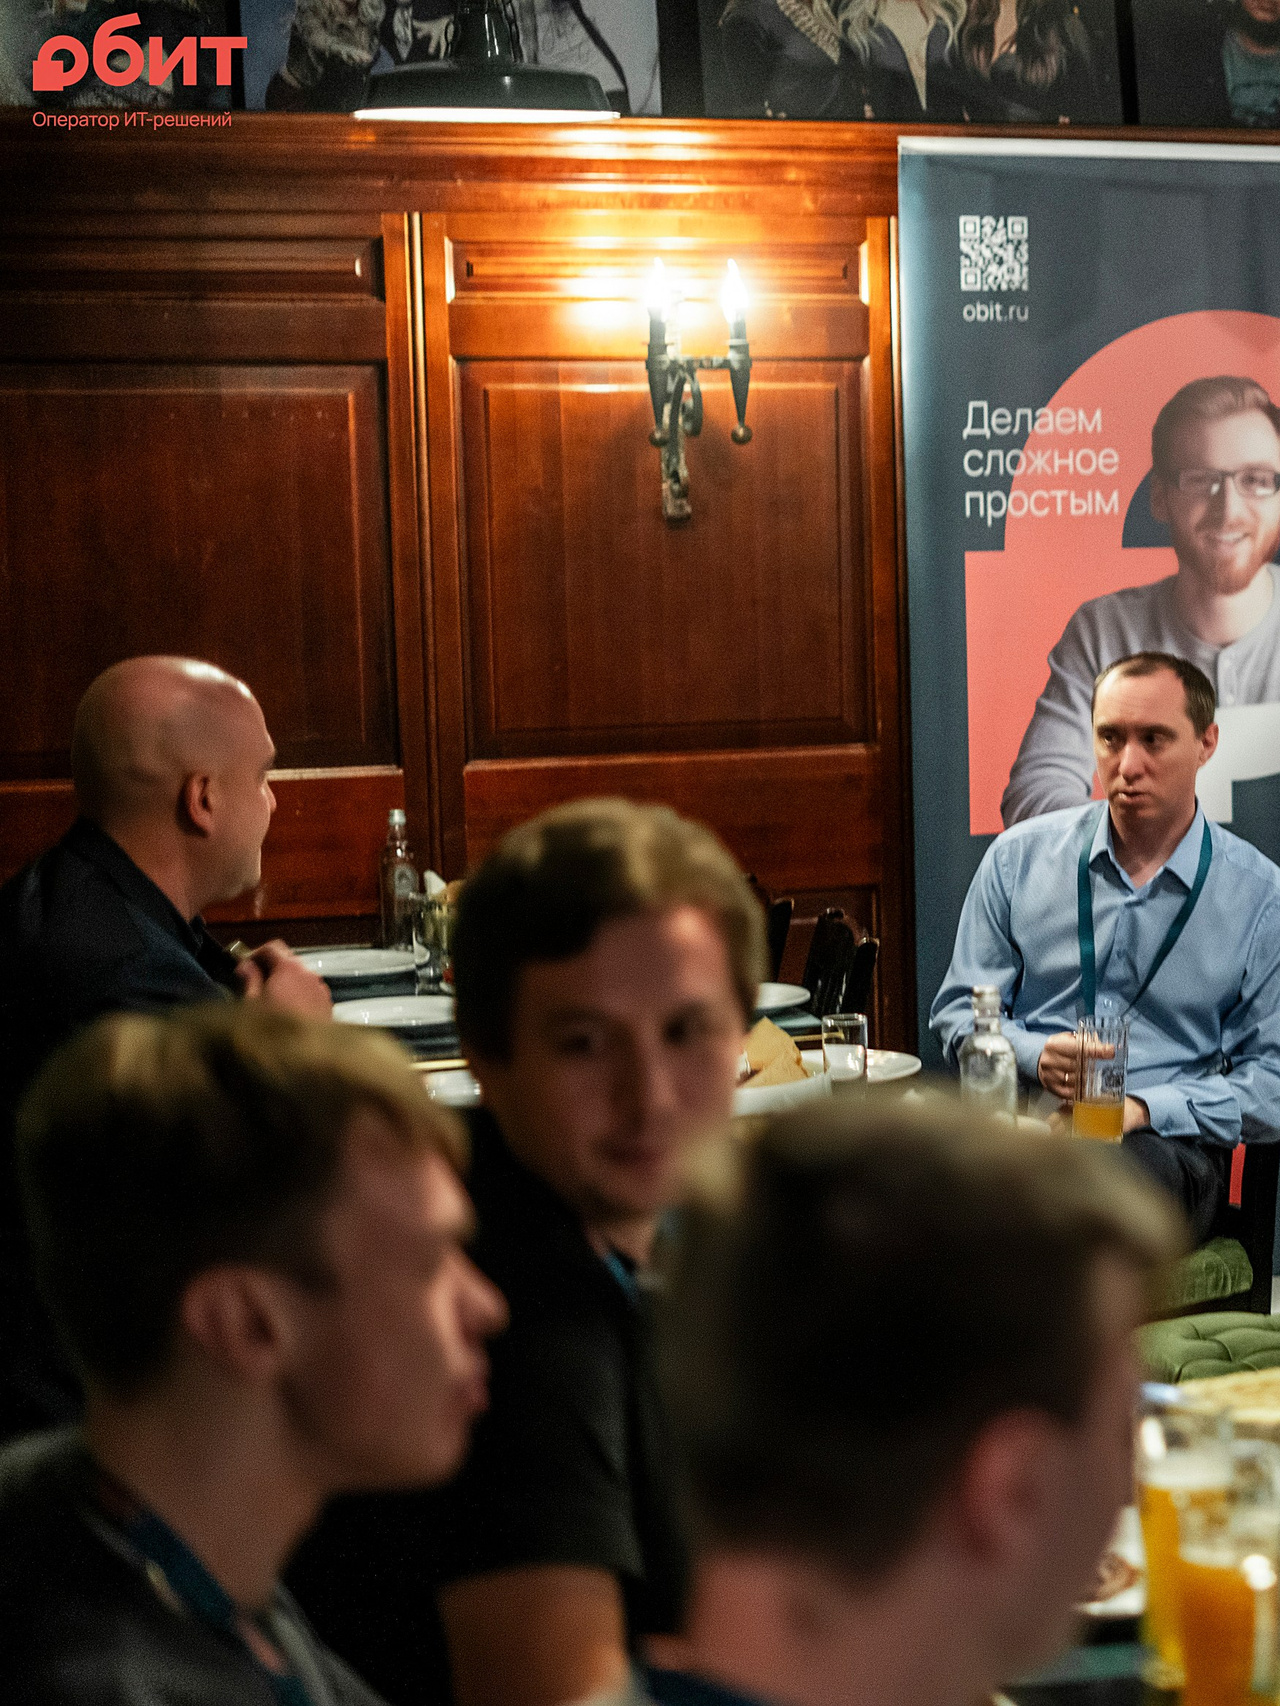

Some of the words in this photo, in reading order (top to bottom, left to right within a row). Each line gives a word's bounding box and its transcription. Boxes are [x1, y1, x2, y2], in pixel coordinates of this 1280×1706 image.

[963, 301, 1030, 322] obit.ru
[962, 400, 1103, 440] Делаем
[963, 447, 1120, 477] сложное
[965, 488, 1120, 527] простым
